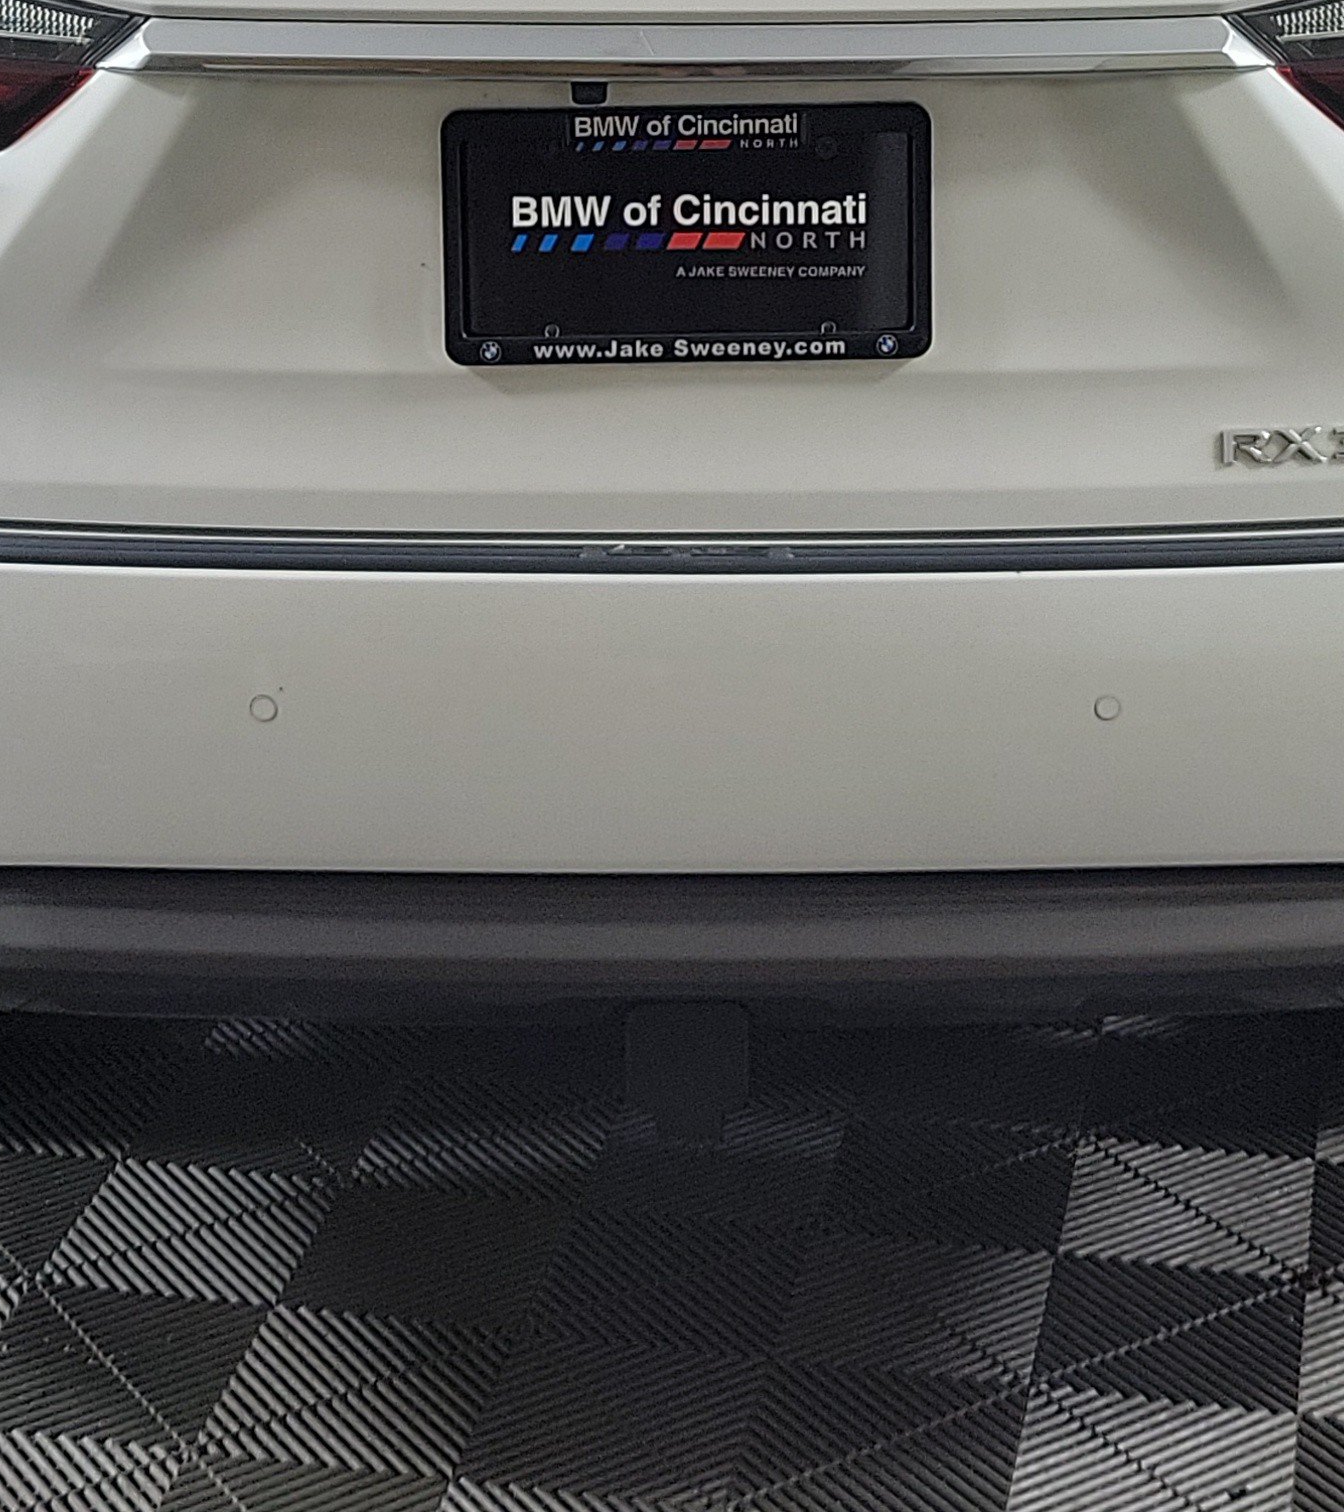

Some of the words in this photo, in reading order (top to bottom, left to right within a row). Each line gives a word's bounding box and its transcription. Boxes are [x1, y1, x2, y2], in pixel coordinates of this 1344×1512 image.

[575, 116, 639, 137] BMW
[648, 115, 672, 136] of
[677, 113, 798, 135] Cincinnati
[740, 139, 799, 149] NORTH
[512, 196, 611, 228] BMW
[622, 195, 661, 226] of
[673, 194, 868, 226] Cincinnati
[750, 231, 866, 249] NORTH
[676, 267, 687, 278] A
[689, 266, 725, 278] JAKE
[728, 266, 795, 278] SWEENEY
[798, 266, 866, 278] COMPANY
[534, 341, 664, 359] www.Jake
[674, 338, 847, 357] Sweeney.com
